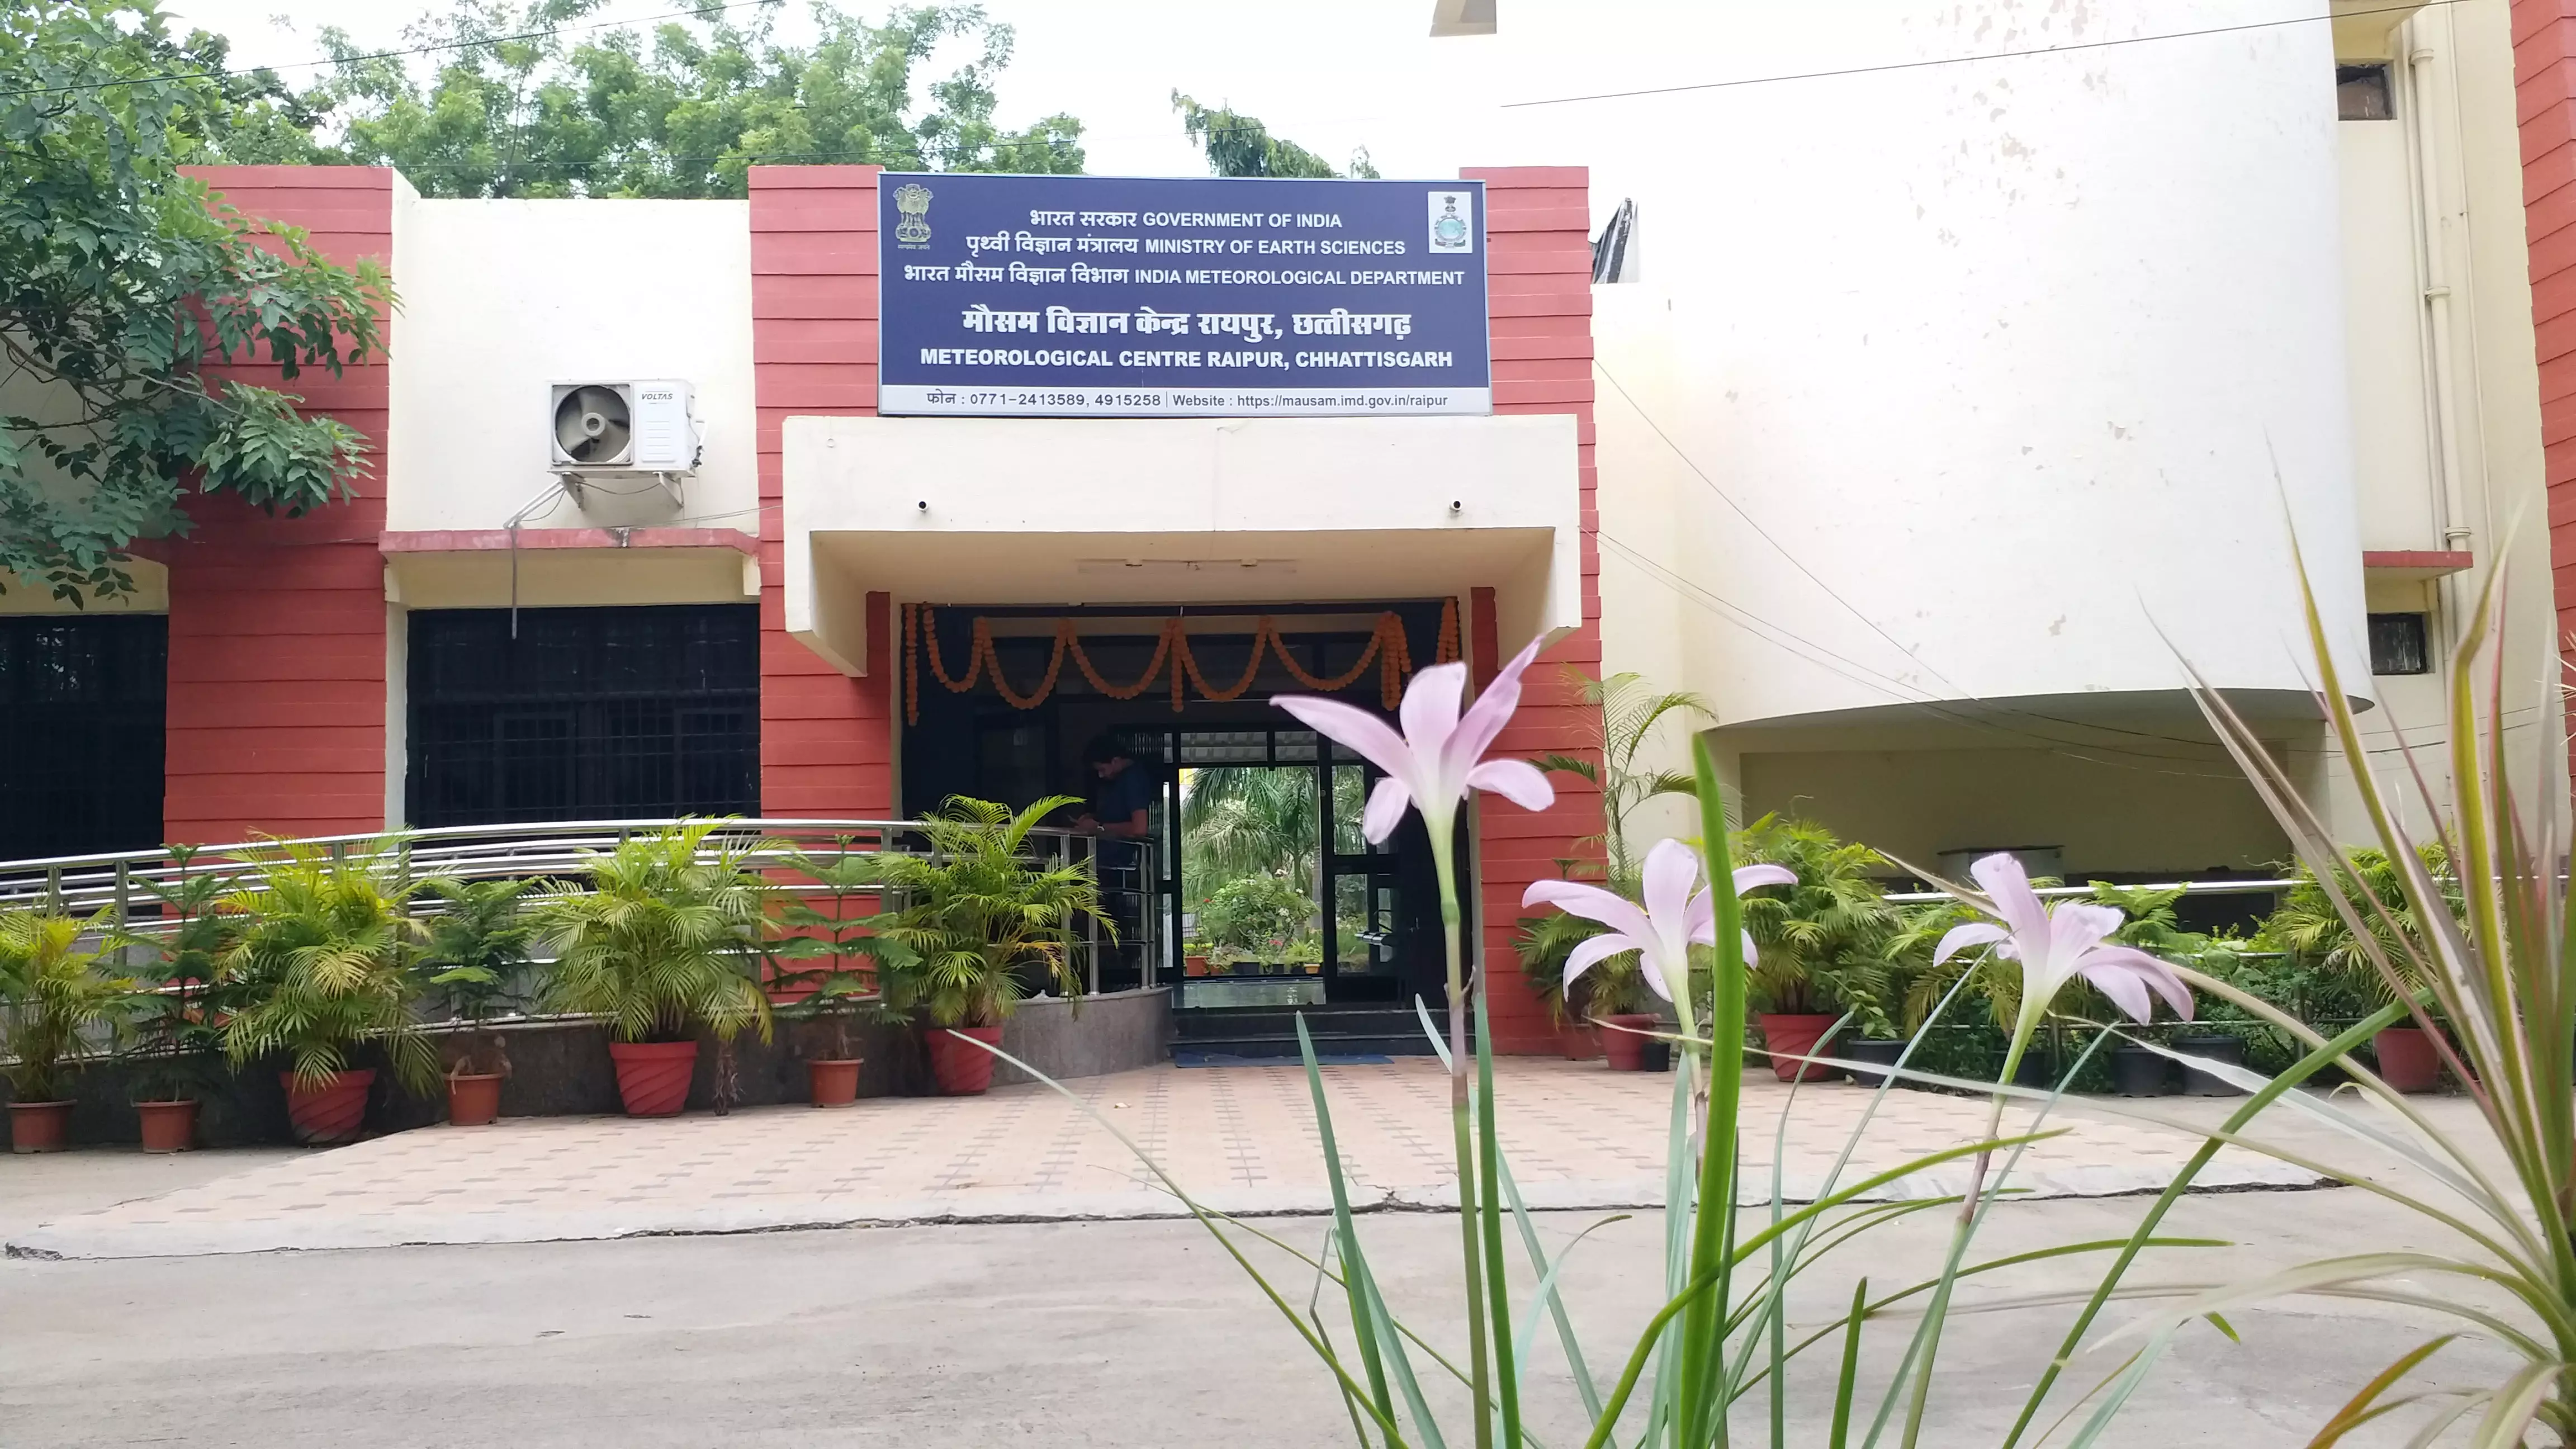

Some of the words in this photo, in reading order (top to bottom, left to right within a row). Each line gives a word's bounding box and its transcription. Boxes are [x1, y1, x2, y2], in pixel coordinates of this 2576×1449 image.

[1030, 210, 1075, 226] भारत
[1079, 211, 1138, 227] सरकार
[1143, 212, 1263, 227] GOVERNMENT
[1268, 213, 1292, 228] OF
[1296, 214, 1343, 228] INDIA
[965, 230, 1011, 258] पृथ्वी
[1014, 230, 1072, 255] विज्ञान
[1076, 233, 1139, 253] मंत्रालय
[1145, 239, 1226, 254] MINISTRY
[1230, 240, 1253, 254] OF
[1258, 240, 1315, 254] EARTH
[1320, 240, 1406, 255] SCIENCES
[904, 264, 951, 281] भारत
[954, 260, 1005, 282] मौसम
[1008, 261, 1067, 286] विज्ञान
[1070, 262, 1130, 284] विभाग
[1135, 269, 1182, 283] INDIA
[1186, 269, 1347, 285] METEOROLOGICAL
[1350, 271, 1465, 285] DEPARTMENT
[962, 304, 1040, 333] मौसम
[1045, 306, 1131, 334] विज्ञान
[1134, 306, 1191, 335] केन्द्र
[1196, 314, 1283, 343] रायपुर,
[1291, 307, 1412, 340] छत्तीसगढ़
[921, 348, 1113, 366] METEOROLOGICAL
[1119, 351, 1201, 367] CENTRE
[1208, 351, 1289, 371] RAIPUR,
[1295, 351, 1452, 367] CHHATTISGARH
[926, 389, 956, 404] फोन
[970, 393, 1090, 408] 0771-2413589,
[1095, 394, 1161, 406] 4915258
[1172, 395, 1225, 406] Website
[1237, 395, 1448, 409] https://mausam.imd.gov.in/raipur
